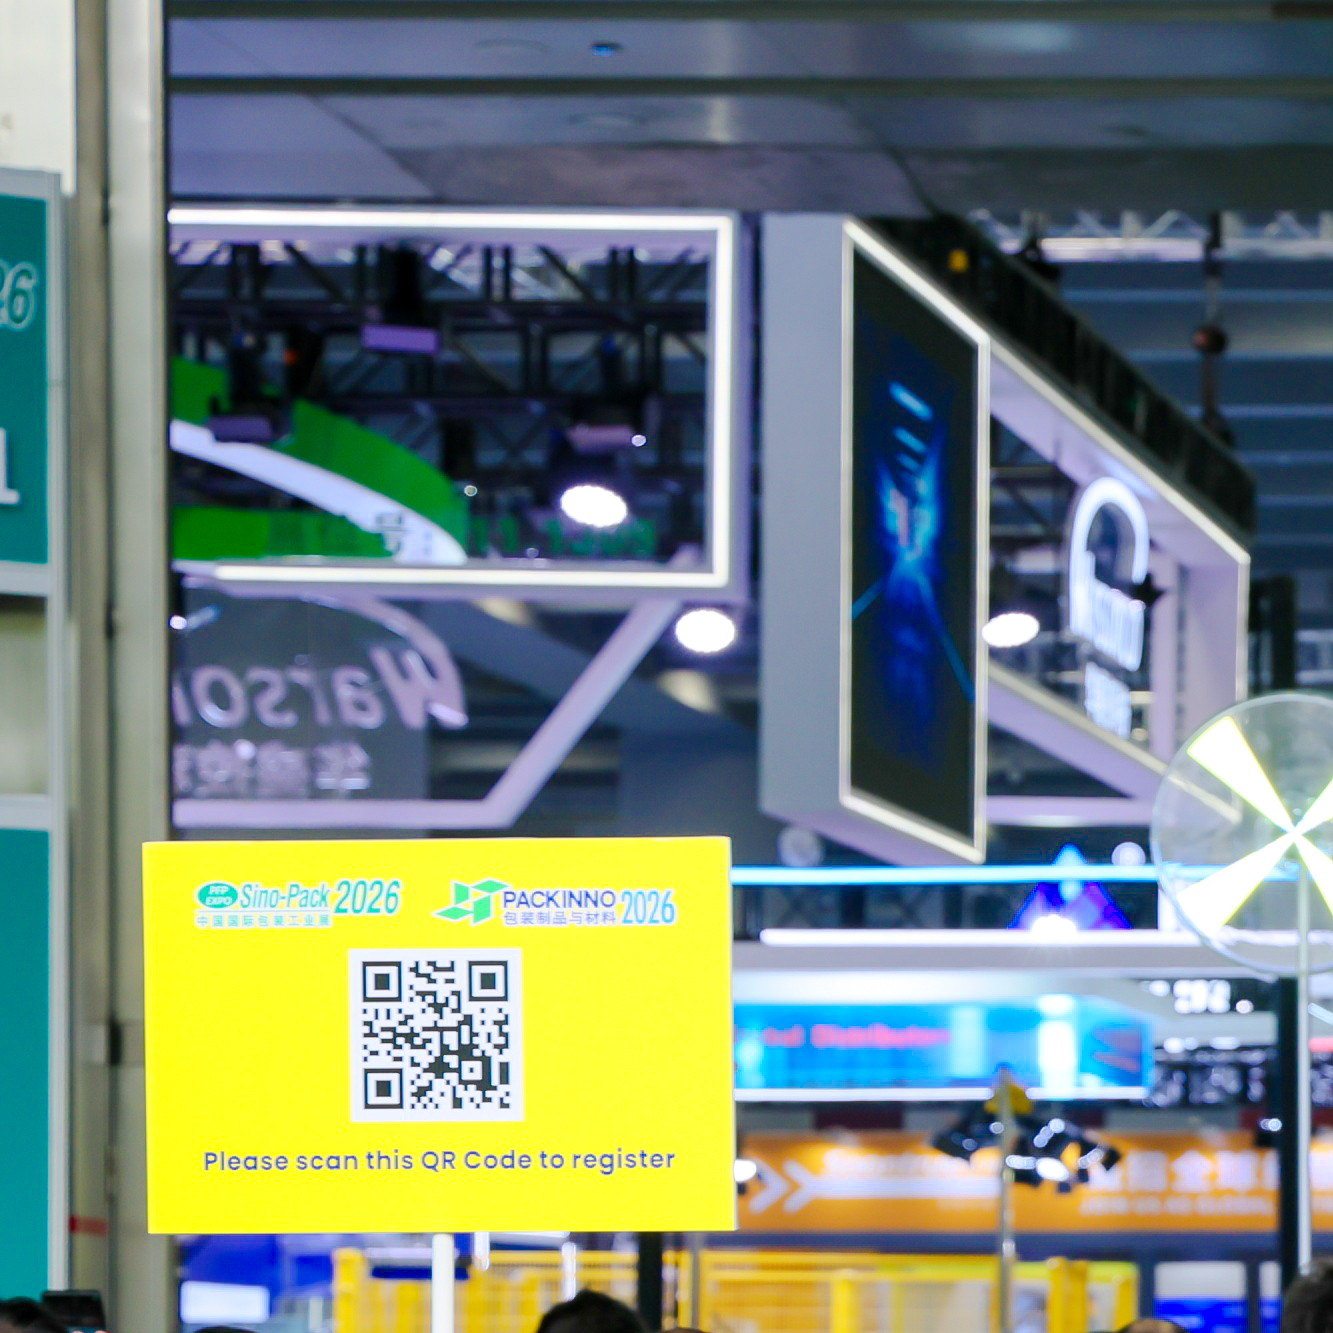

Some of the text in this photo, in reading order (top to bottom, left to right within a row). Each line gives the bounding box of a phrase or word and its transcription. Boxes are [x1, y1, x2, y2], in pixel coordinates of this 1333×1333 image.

[240, 880, 400, 914] Sino-Pack 2026
[503, 890, 676, 925] PACKINNO 2026
[503, 911, 617, 926] 包装制品与材料
[203, 1148, 676, 1175] Please scan this QR Code to register
